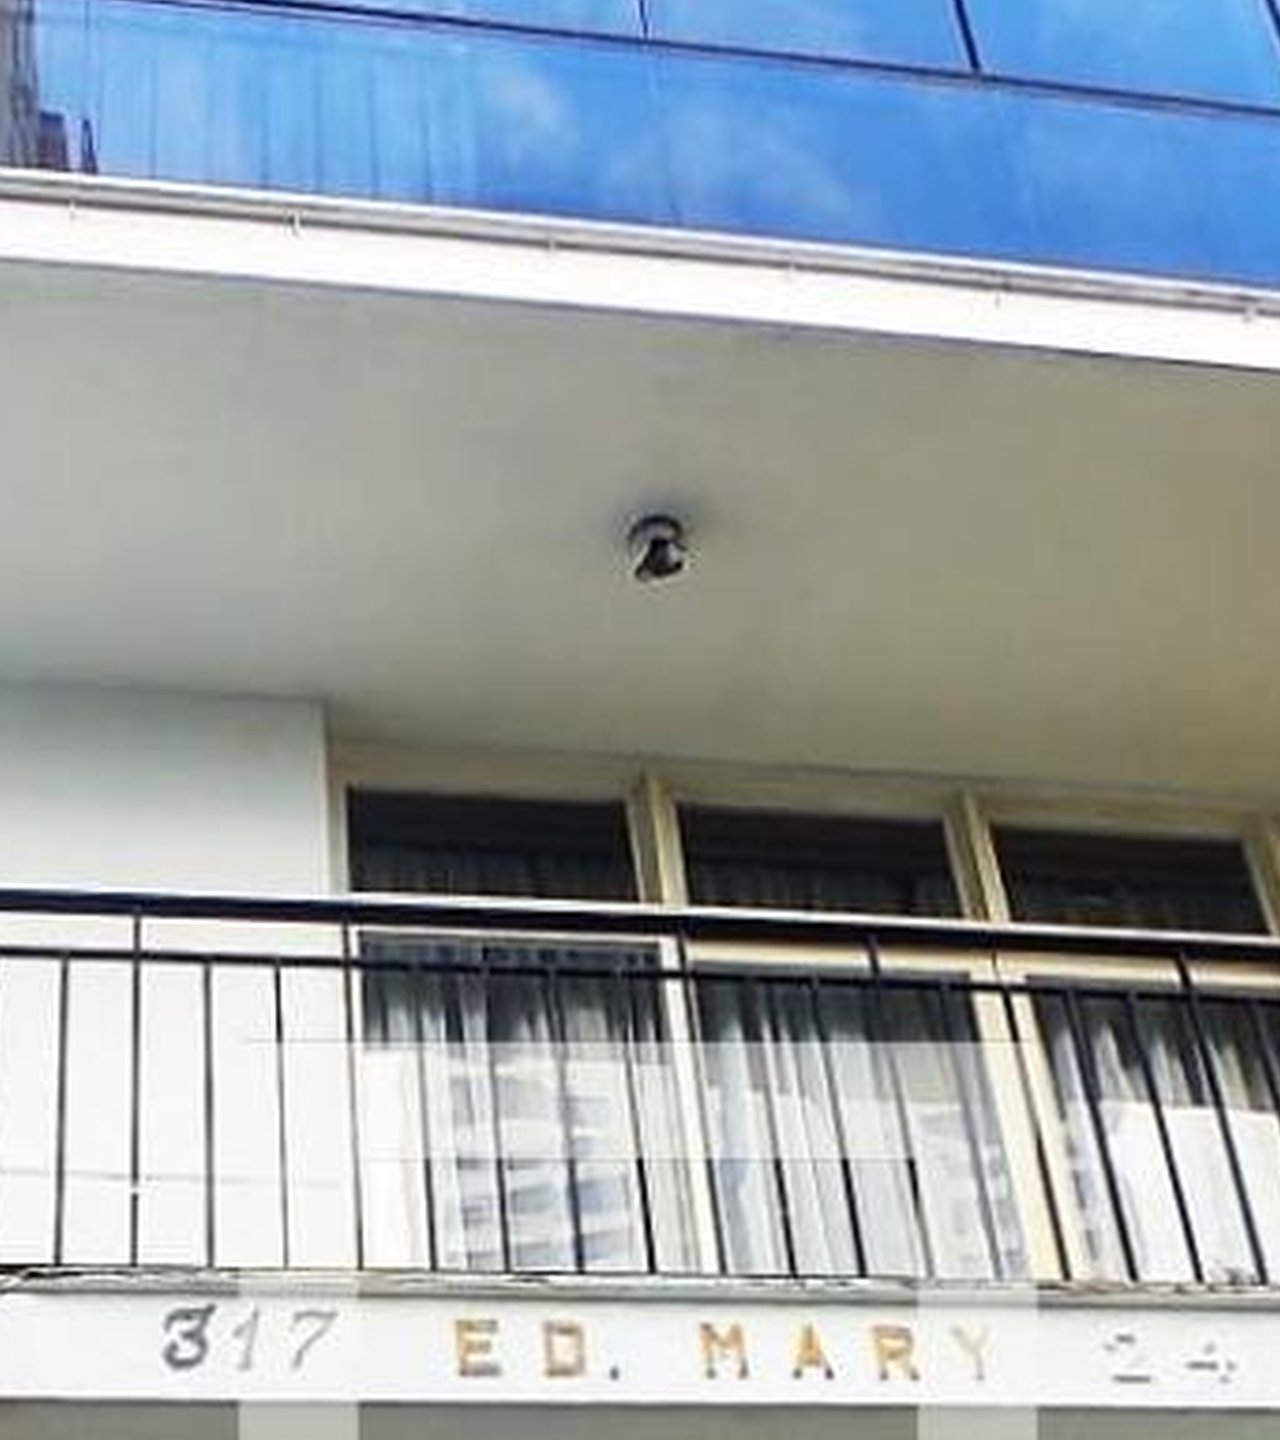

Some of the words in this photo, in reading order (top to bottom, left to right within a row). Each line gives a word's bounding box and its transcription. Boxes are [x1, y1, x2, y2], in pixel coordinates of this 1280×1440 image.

[162, 1303, 339, 1371] 317
[454, 1318, 620, 1381] ED.
[698, 1322, 990, 1382] MARY
